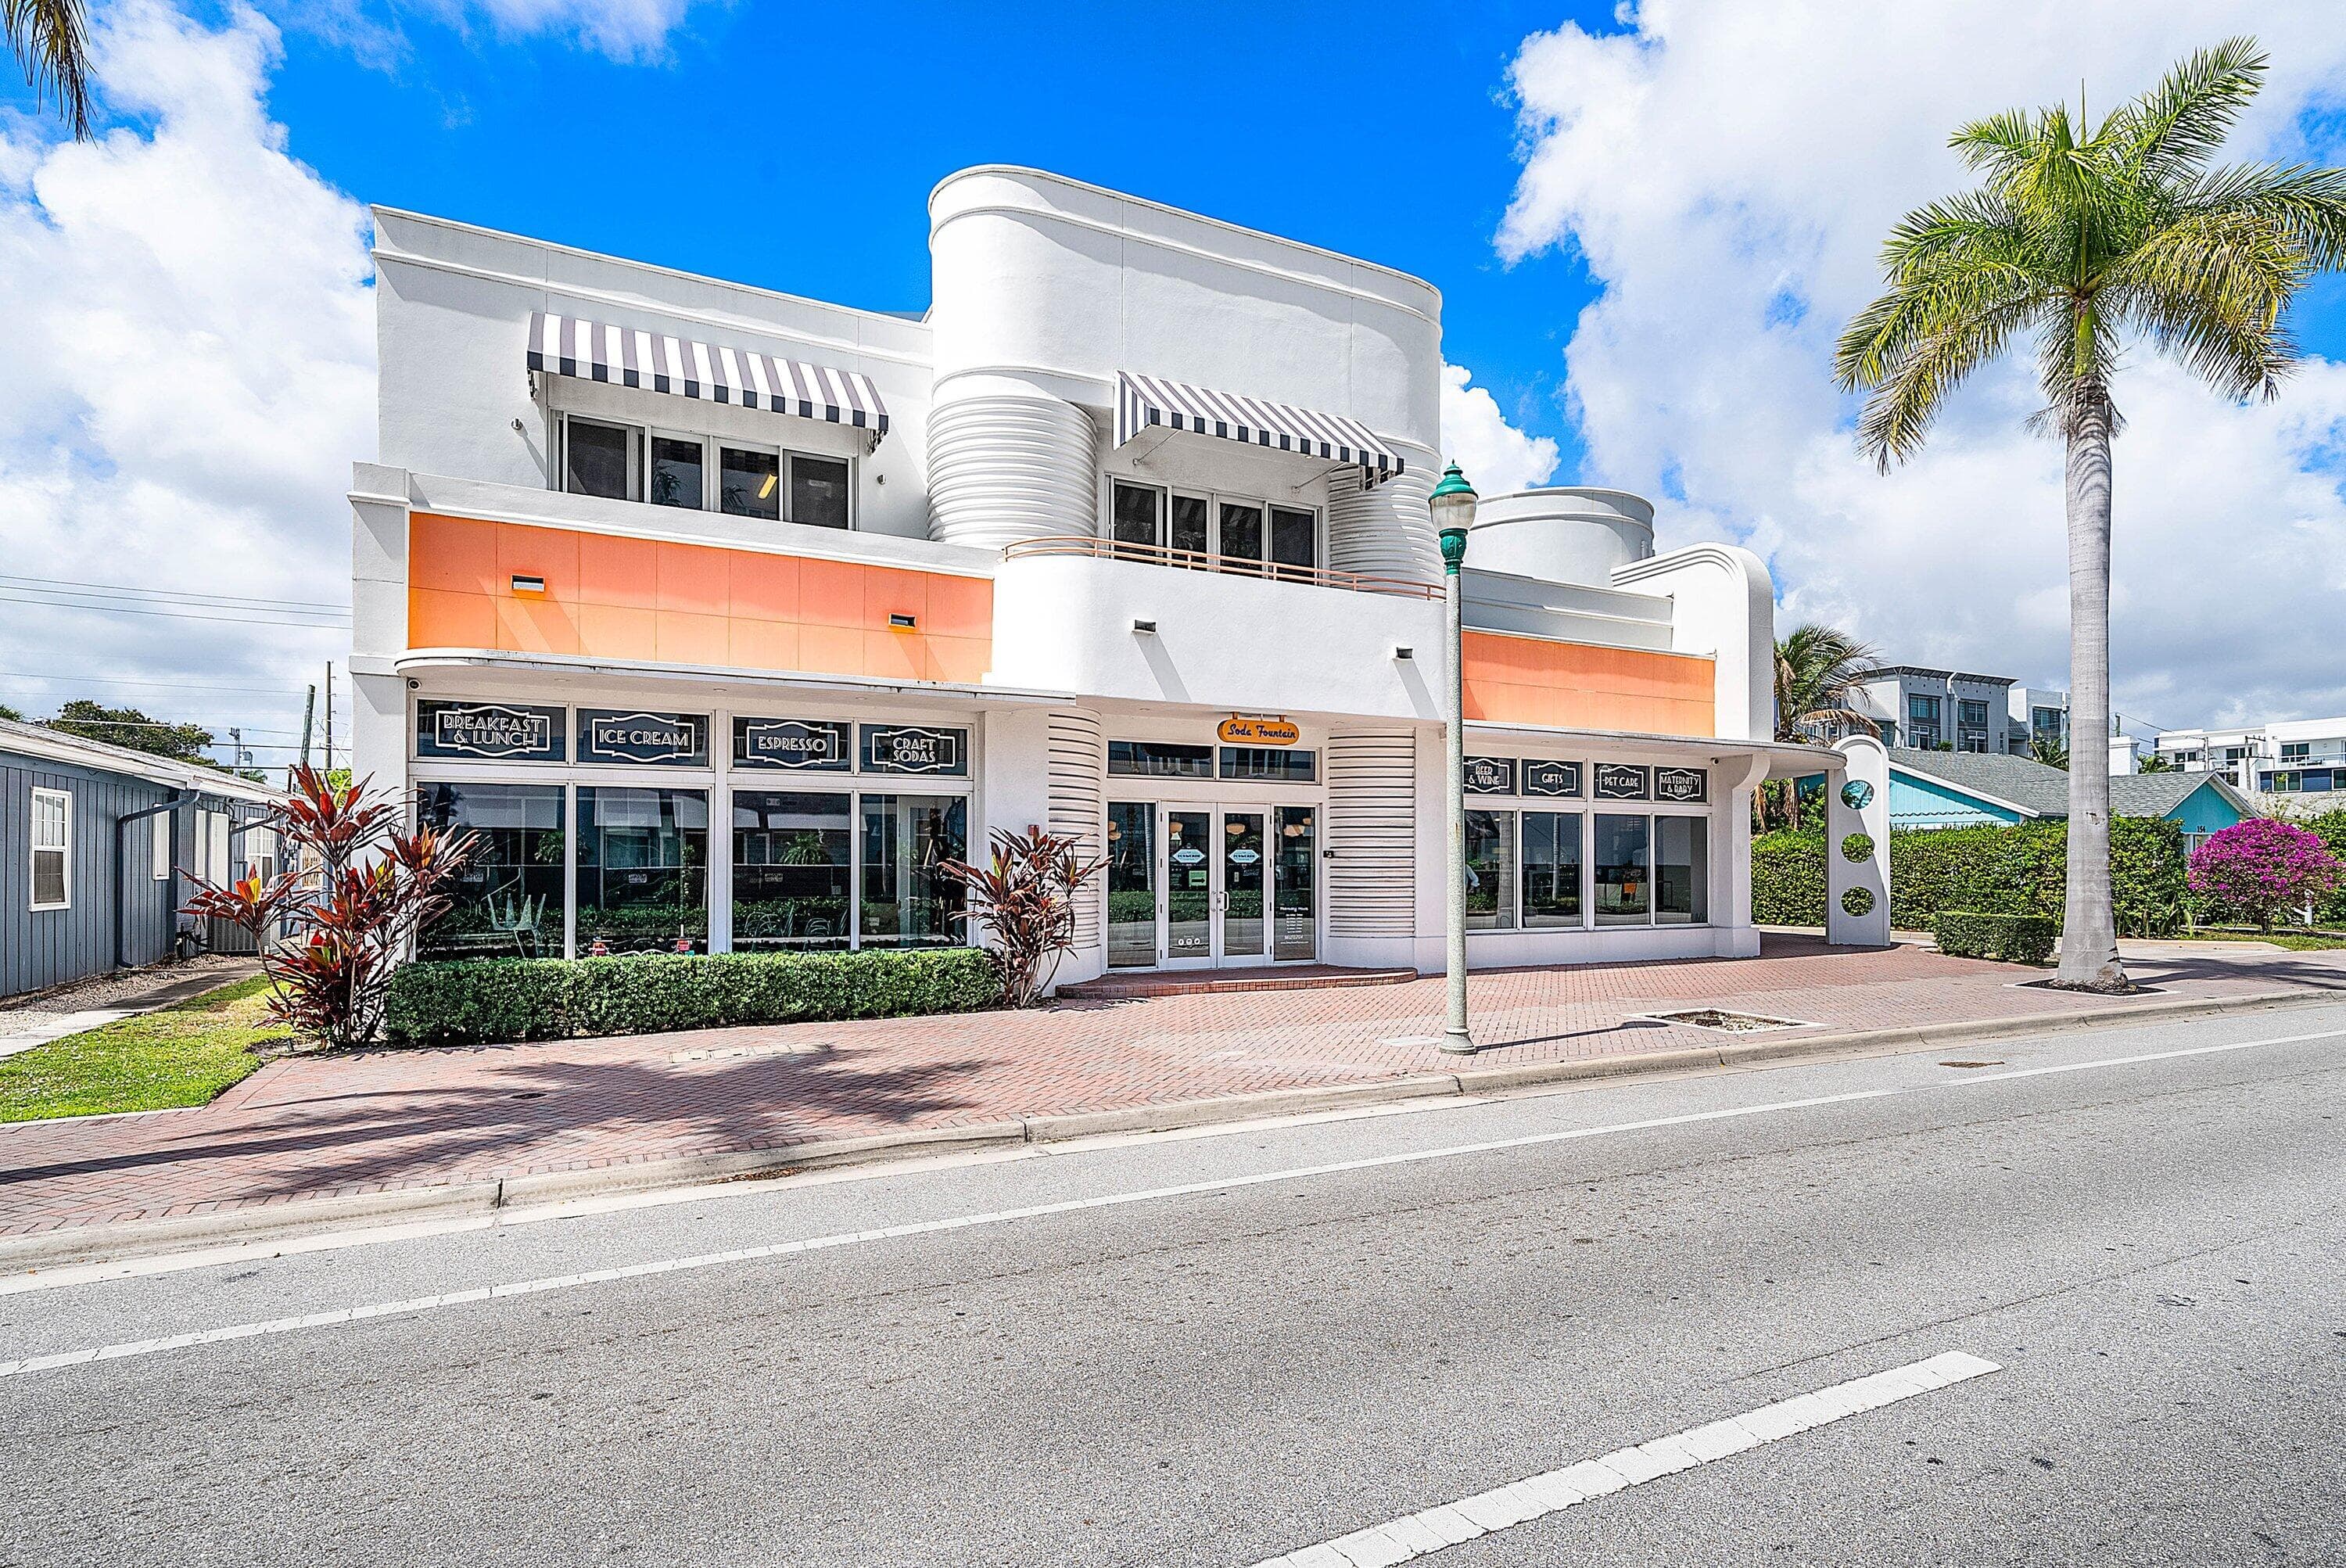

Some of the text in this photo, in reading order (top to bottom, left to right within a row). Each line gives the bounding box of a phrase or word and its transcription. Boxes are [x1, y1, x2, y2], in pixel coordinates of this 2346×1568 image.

[443, 715, 542, 734] BREAKFAST
[1228, 723, 1296, 738] Soda Fountain
[454, 730, 538, 746] & LUNCH
[599, 729, 689, 746] ICE CREAM
[758, 736, 827, 752] ESPRESSO
[893, 737, 935, 752] CRAFT
[893, 749, 935, 762] SODAS
[1476, 766, 1493, 775] BEER
[1469, 775, 1500, 785] & WINE
[1541, 773, 1563, 784] GIFTS
[1604, 776, 1639, 788] PET CARE
[1661, 775, 1699, 785] MATERNITY
[1673, 784, 1692, 794] BABY
